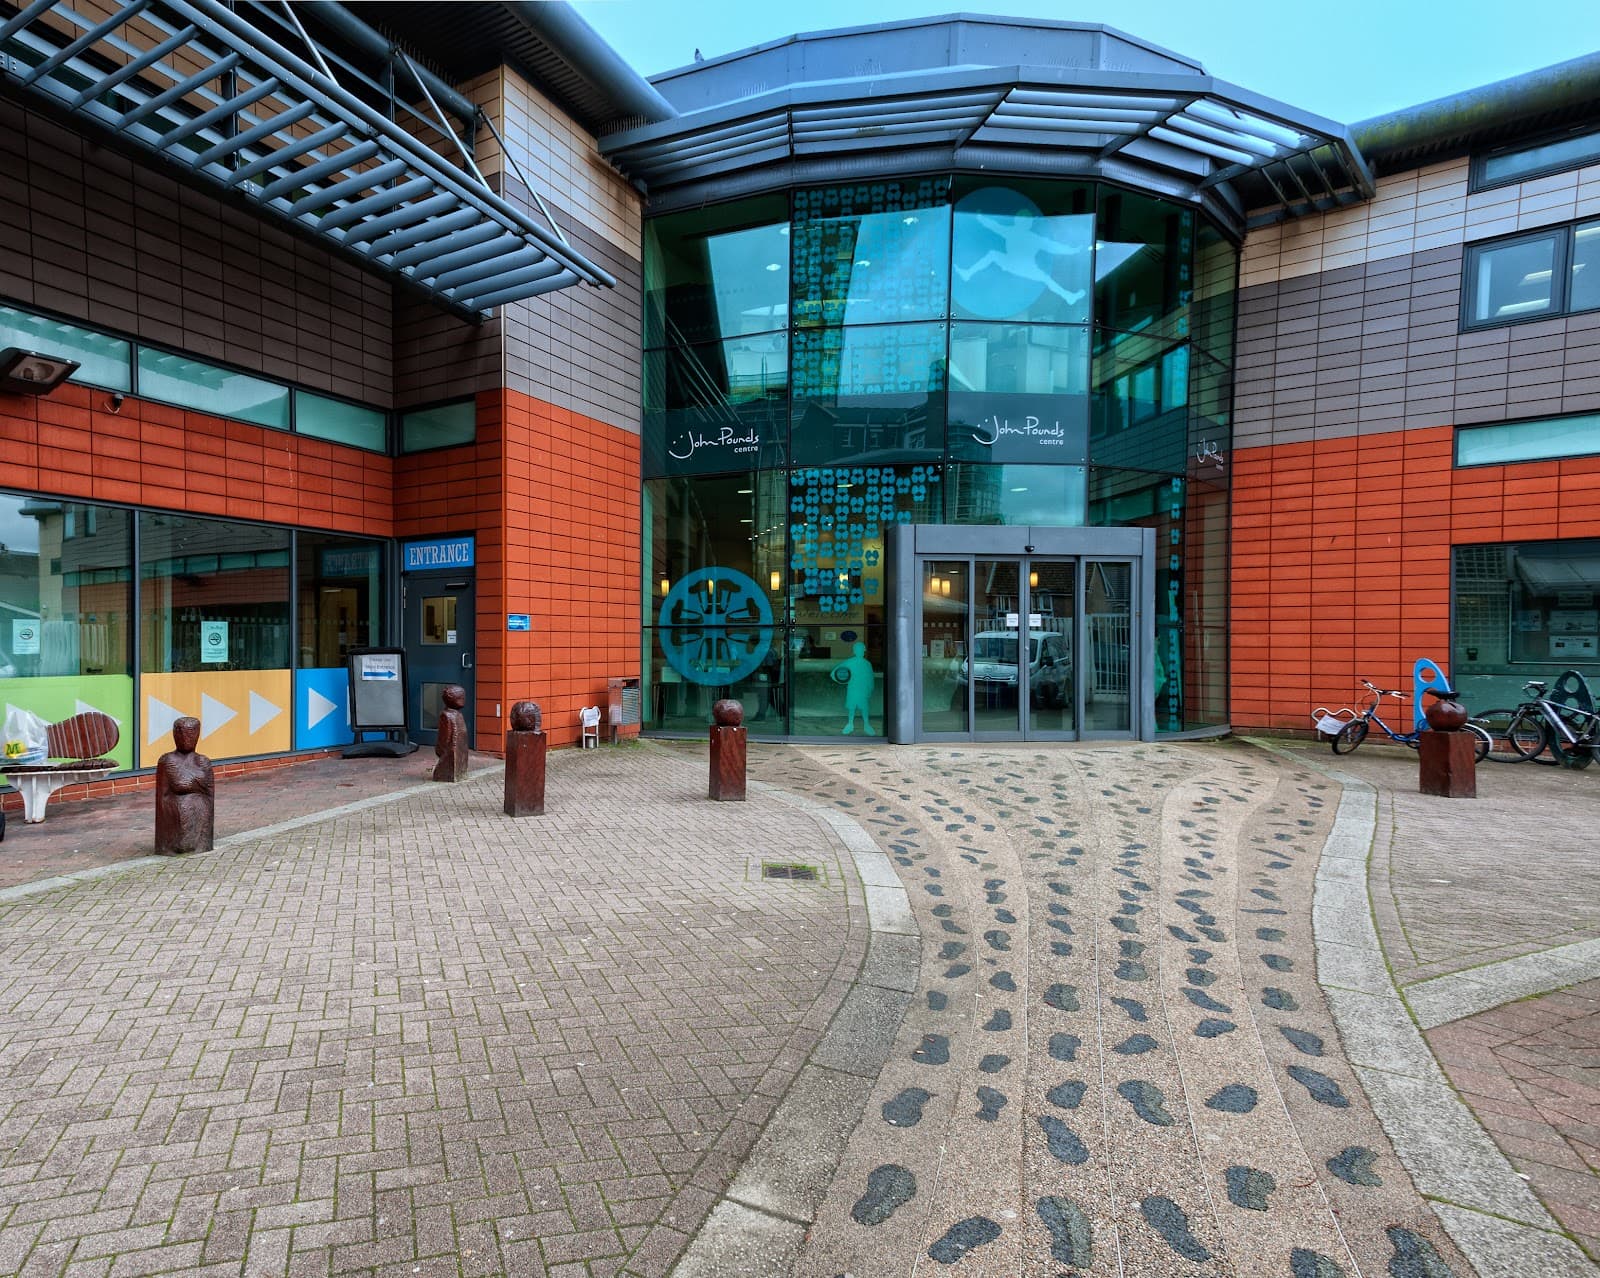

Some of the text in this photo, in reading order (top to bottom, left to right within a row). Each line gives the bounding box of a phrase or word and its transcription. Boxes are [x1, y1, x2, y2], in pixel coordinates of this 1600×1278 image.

[972, 415, 1065, 445] John Pounds
[1039, 438, 1064, 446] centre
[668, 426, 760, 459] John Pounds
[733, 446, 759, 454] centre
[409, 542, 469, 566] ENTRANCE
